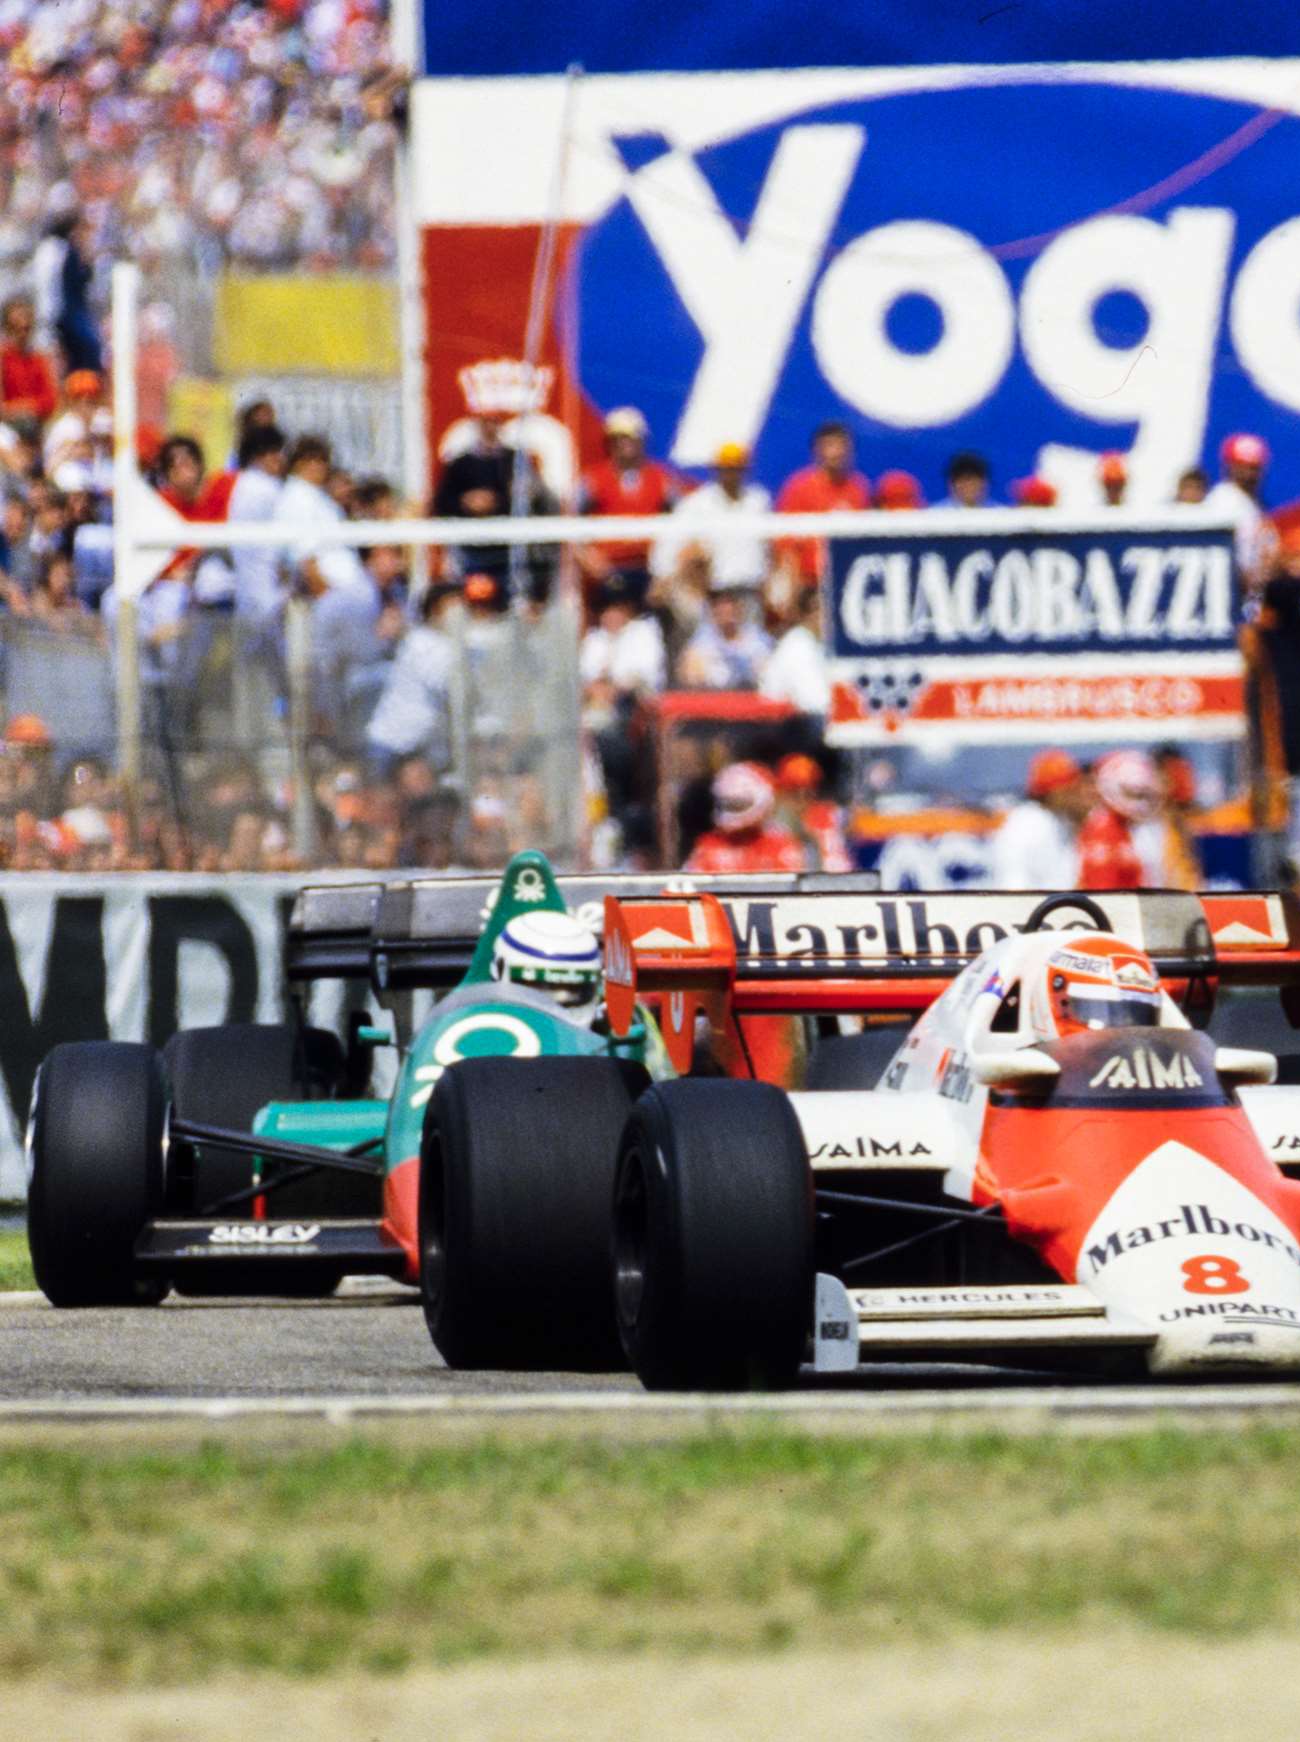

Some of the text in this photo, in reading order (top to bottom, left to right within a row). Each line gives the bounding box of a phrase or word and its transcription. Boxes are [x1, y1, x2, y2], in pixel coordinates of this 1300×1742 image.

[839, 545, 1233, 646] GIACOBAZZI
[727, 902, 1103, 957] Marlbo
[208, 1223, 321, 1244] SISLEY
[1181, 1254, 1250, 1296] 8
[899, 1292, 1063, 1305] HERCULES
[1159, 1302, 1299, 1322] UNIPART
